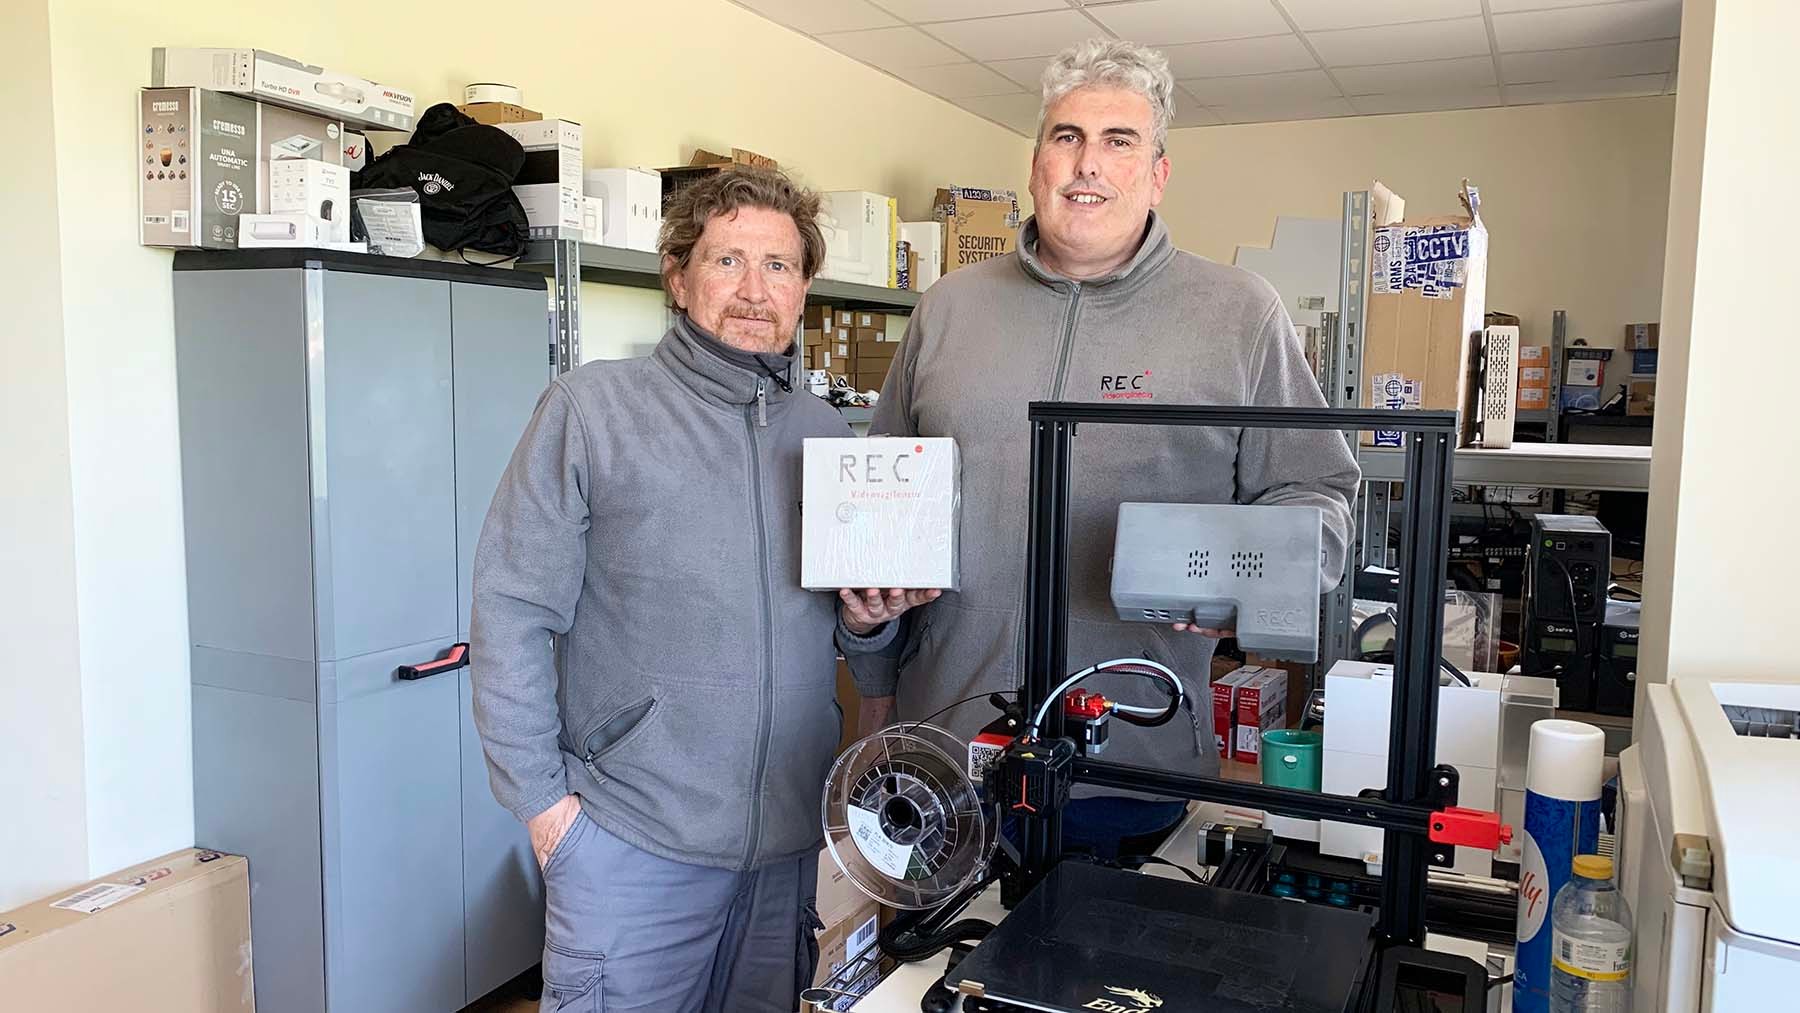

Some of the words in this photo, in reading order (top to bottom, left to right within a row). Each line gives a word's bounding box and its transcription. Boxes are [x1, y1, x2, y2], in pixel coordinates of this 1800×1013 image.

[262, 80, 277, 91] Turbo
[279, 85, 287, 93] HD
[288, 87, 301, 96] DVR
[382, 90, 412, 103] HIKVISION
[209, 153, 248, 167] AUTOMATIC
[221, 148, 235, 157] UNA
[222, 189, 237, 203] 15
[958, 234, 1007, 251] SECURITY
[1416, 236, 1464, 260] CCTV
[958, 250, 1005, 265] SYSTE
[1101, 375, 1144, 390] REC
[839, 454, 910, 483] REC
[1256, 608, 1295, 626] REC
